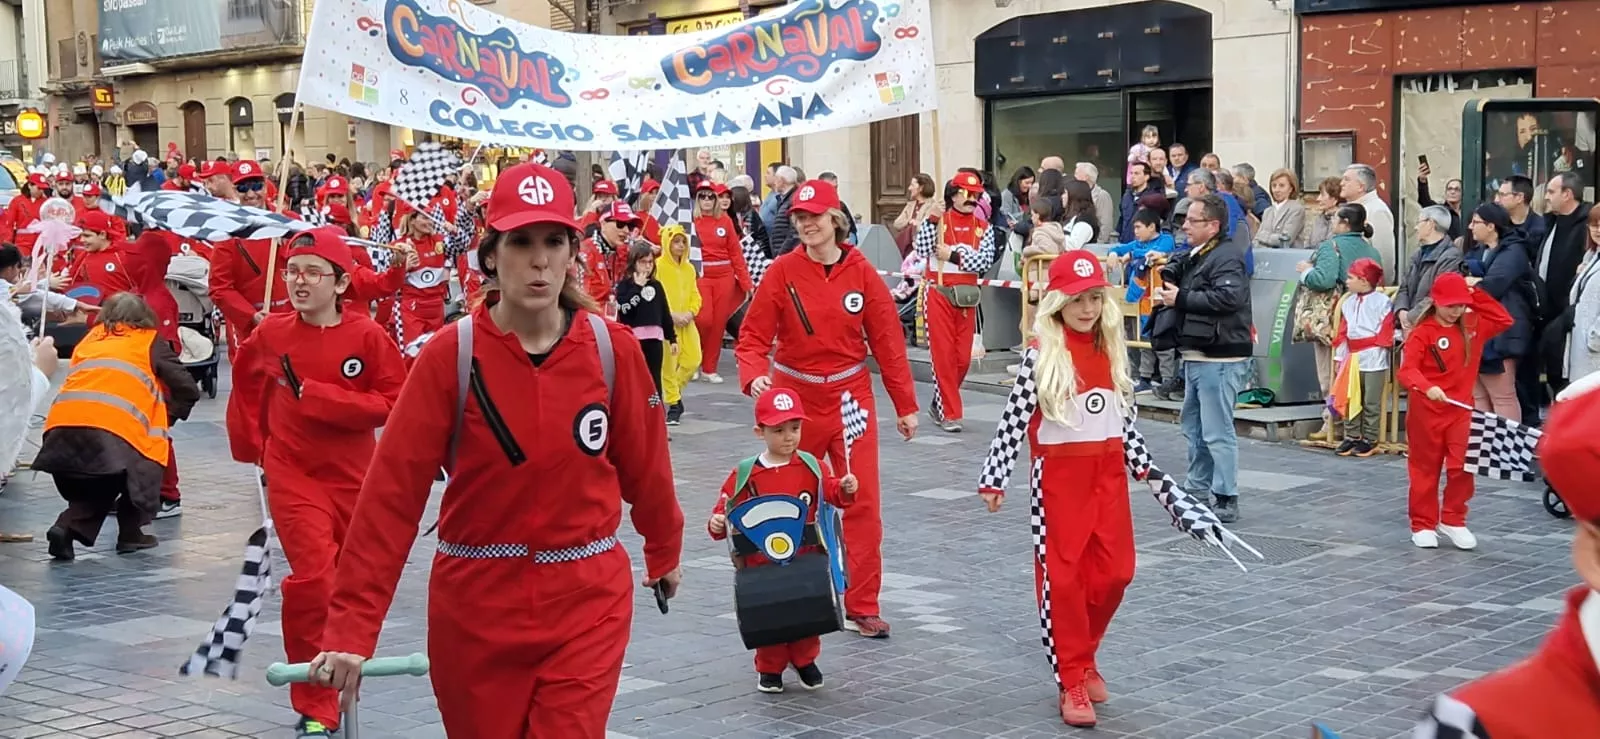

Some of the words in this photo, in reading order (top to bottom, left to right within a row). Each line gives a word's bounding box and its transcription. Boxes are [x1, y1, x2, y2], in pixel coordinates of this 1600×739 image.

[399, 88, 409, 105] 8
[429, 99, 594, 141] COLEGIO
[611, 111, 742, 141] SANTA
[750, 92, 834, 130] ANA
[518, 175, 554, 205] SA
[1073, 258, 1094, 277] SA
[850, 297, 859, 308] 5
[1272, 293, 1291, 343] VIDRIO
[348, 363, 358, 373] 5
[773, 393, 793, 410] SA
[1091, 399, 1100, 408] 5
[589, 417, 603, 442] 5
